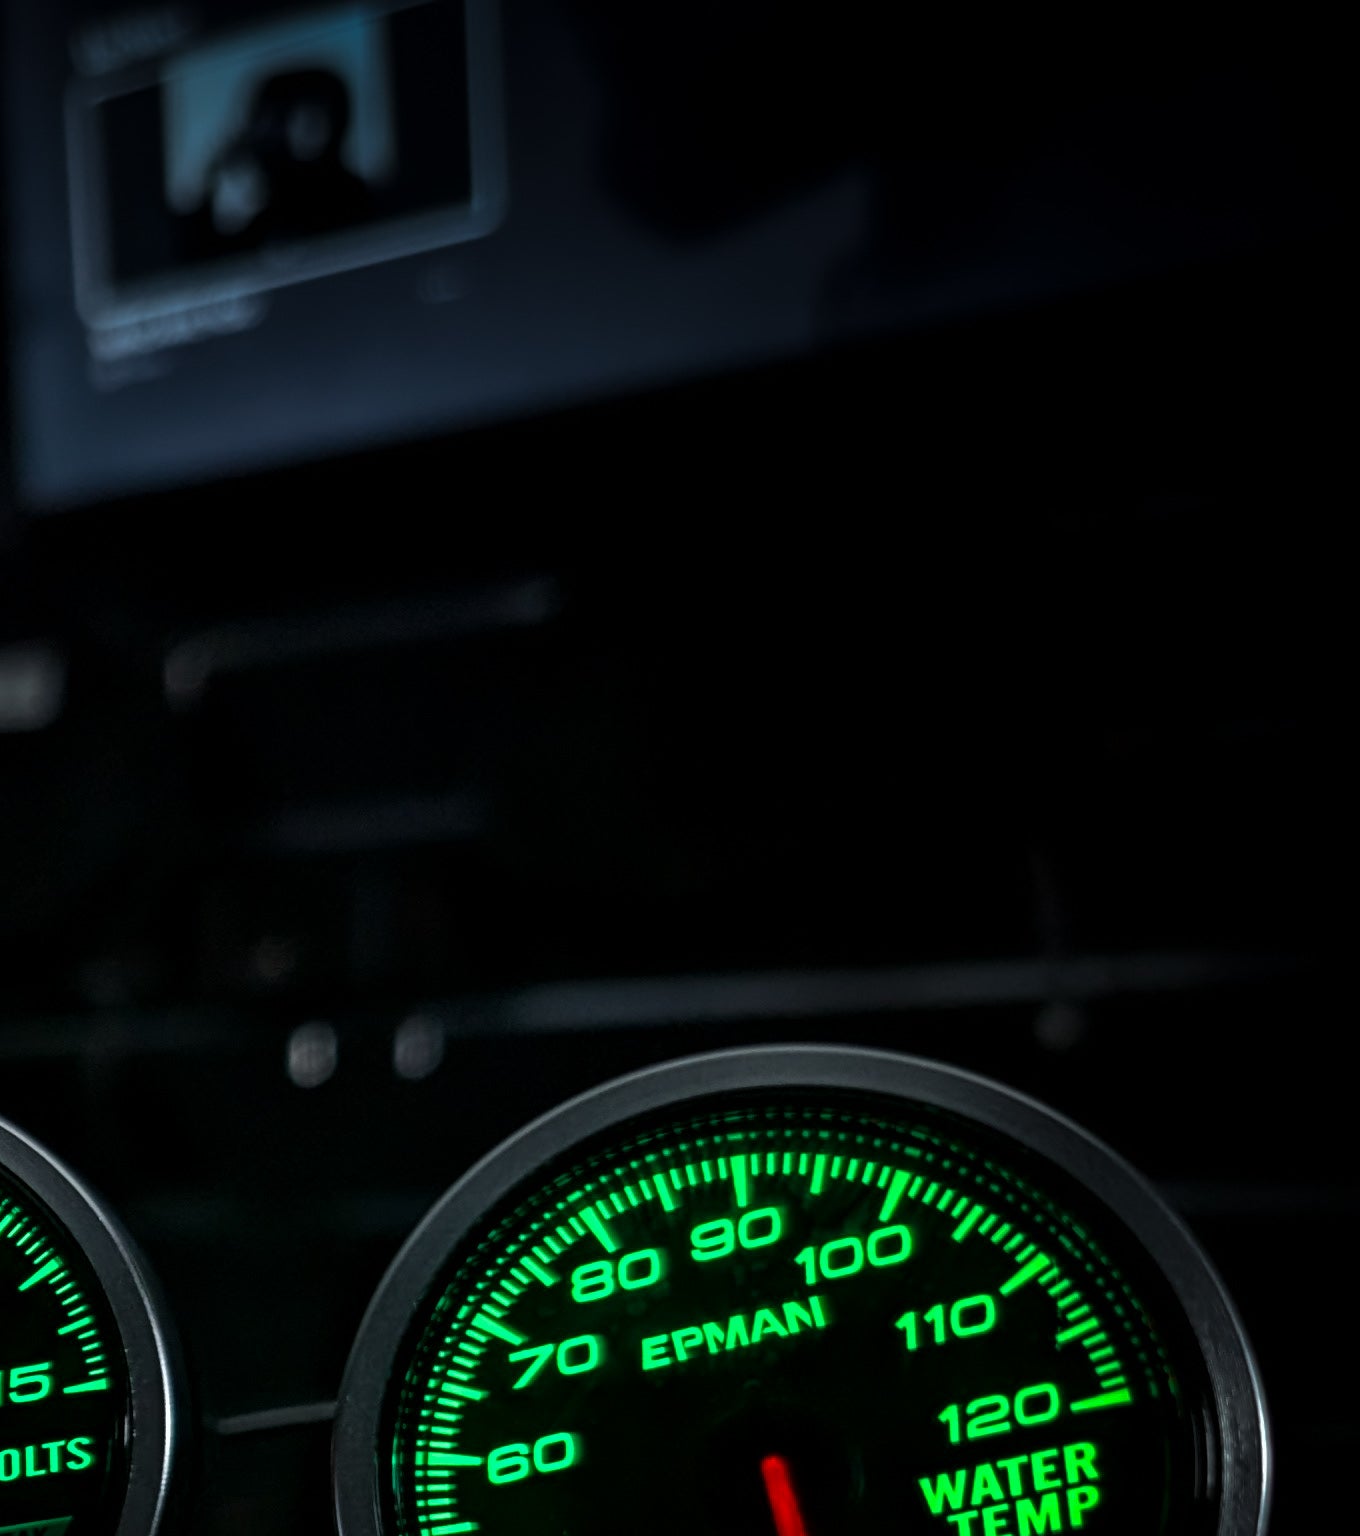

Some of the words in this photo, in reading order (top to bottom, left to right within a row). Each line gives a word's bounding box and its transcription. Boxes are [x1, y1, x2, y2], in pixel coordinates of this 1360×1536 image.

[691, 1206, 783, 1263] 90
[795, 1224, 912, 1285] 100
[571, 1247, 664, 1303] 80
[641, 1296, 828, 1371] EPMAN
[894, 1294, 997, 1351] 110
[507, 1334, 600, 1389] 70
[937, 1382, 1061, 1443] 120
[486, 1432, 576, 1484] 60
[917, 1441, 1100, 1517] WATER
